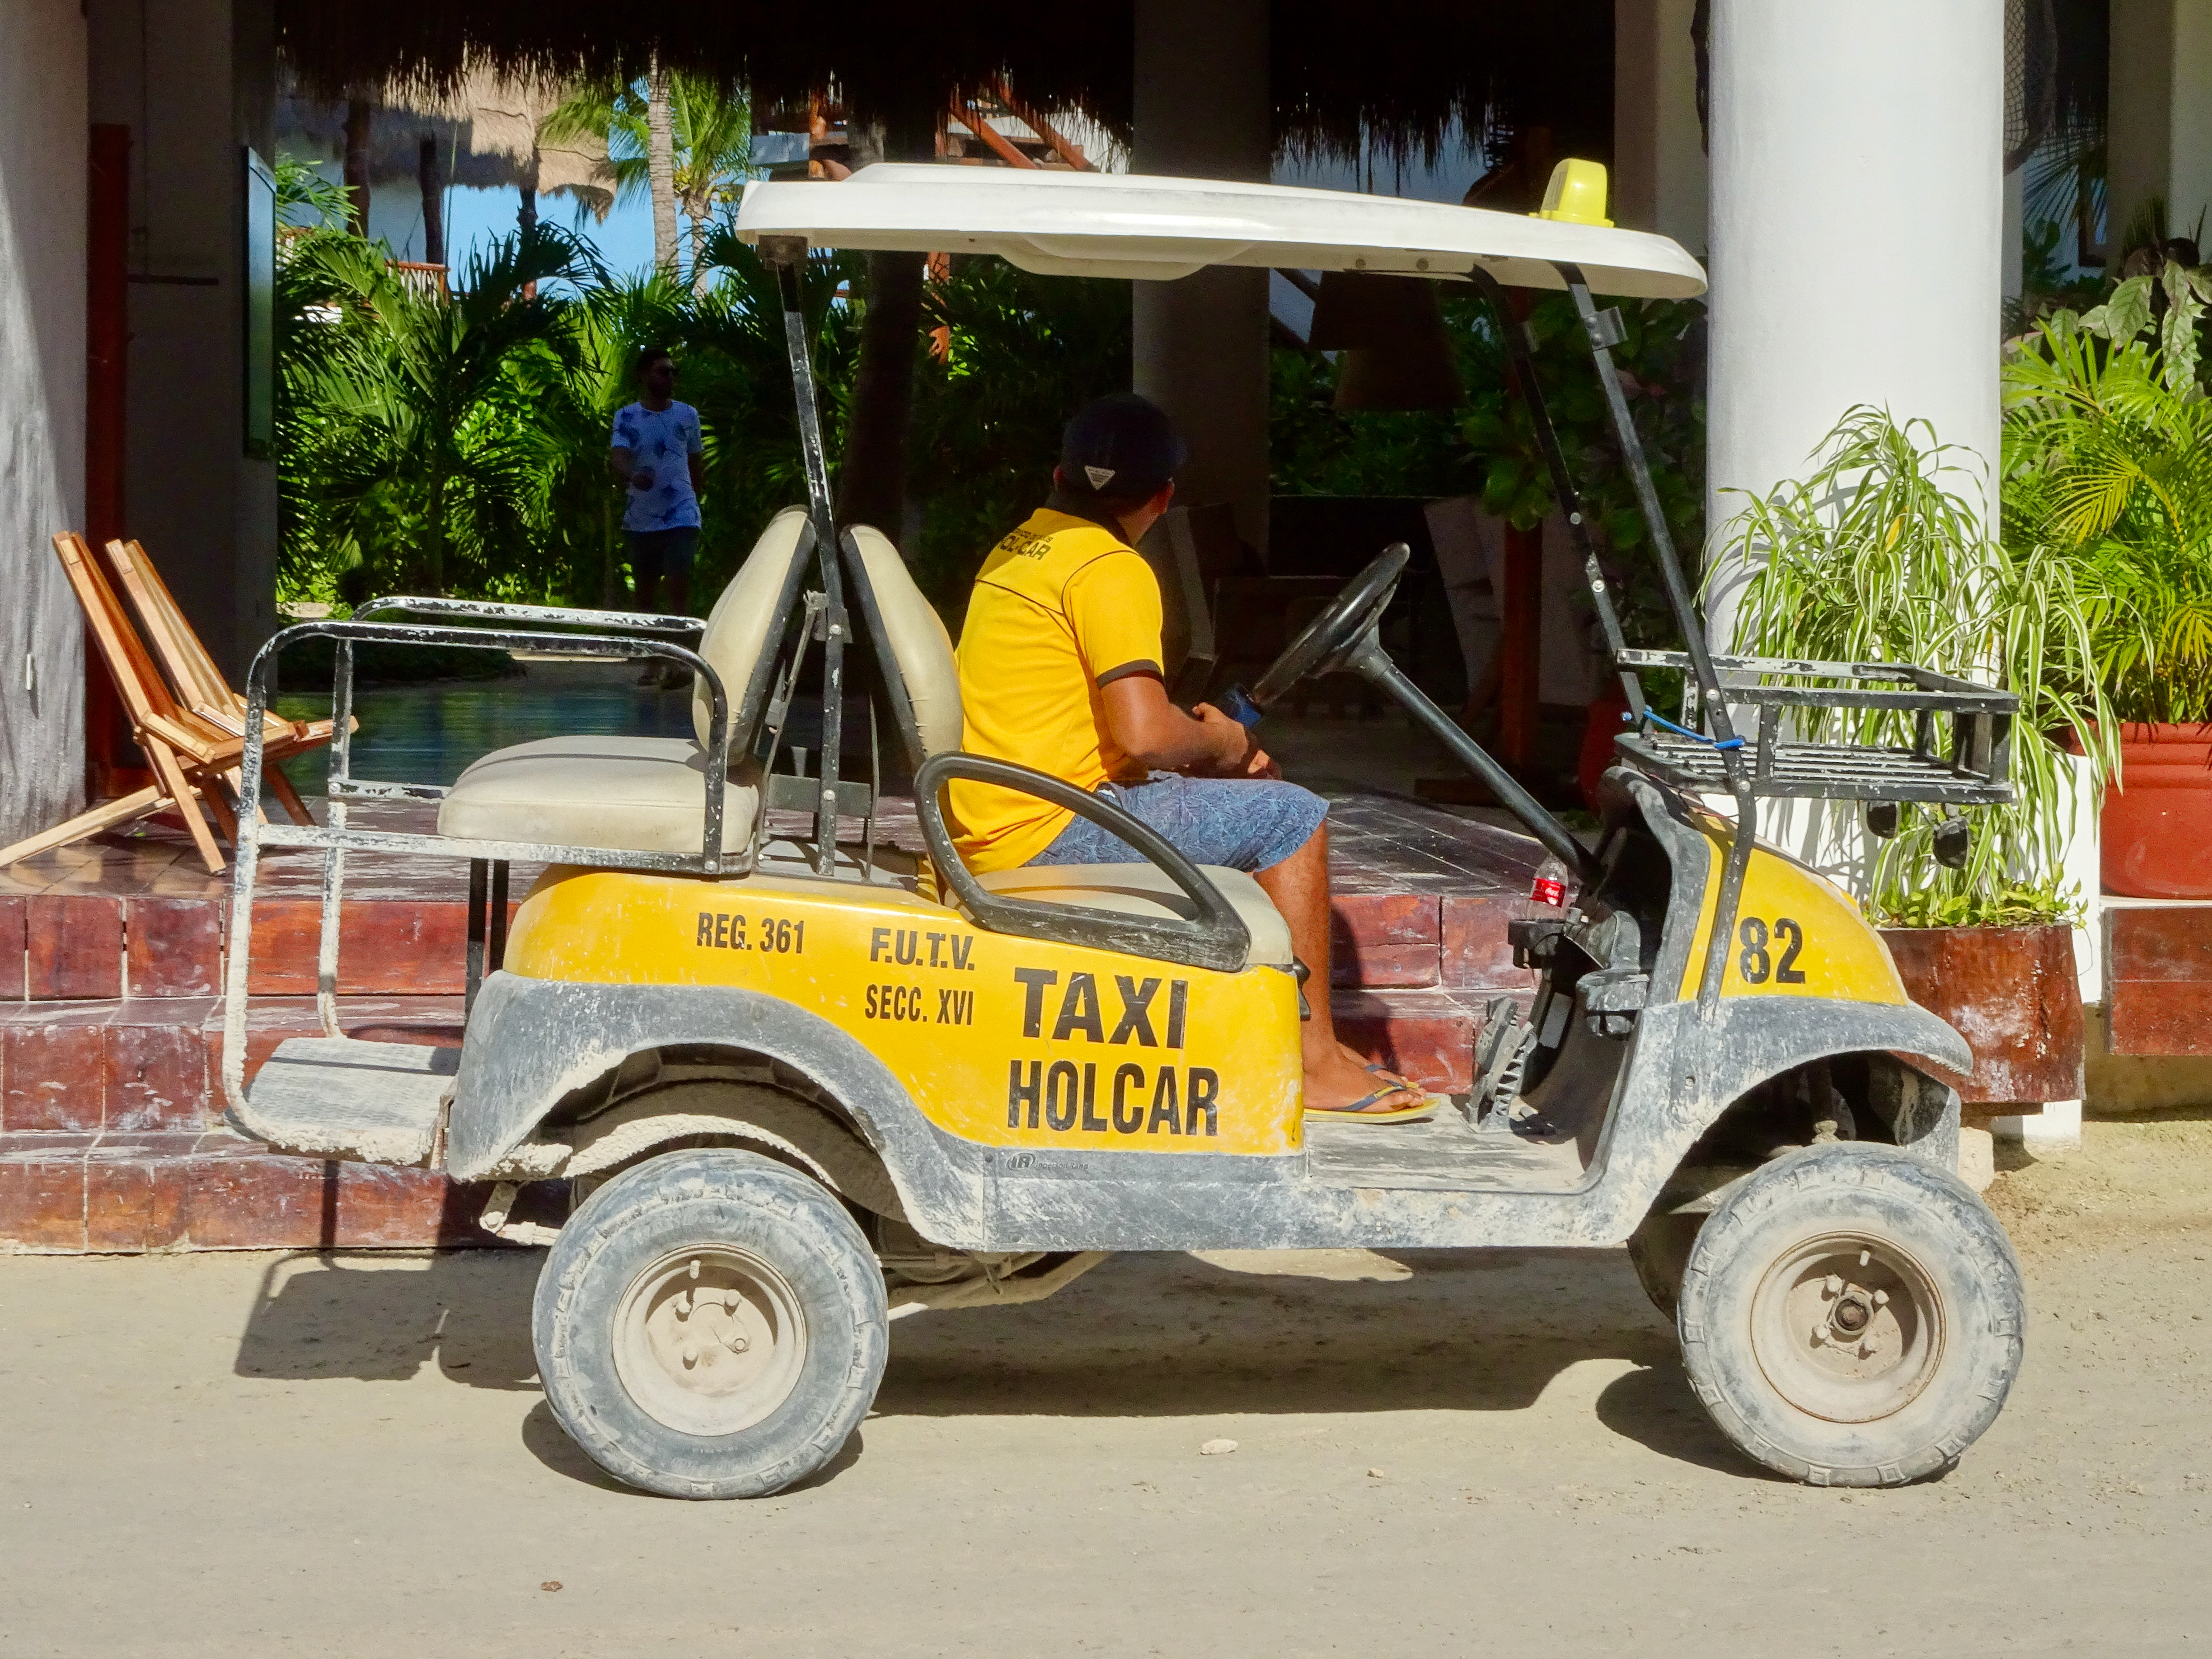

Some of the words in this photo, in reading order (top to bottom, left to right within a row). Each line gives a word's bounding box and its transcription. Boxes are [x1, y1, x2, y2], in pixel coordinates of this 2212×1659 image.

[999, 535, 1052, 561] OLCAR
[696, 912, 752, 950] REG.
[759, 918, 804, 954] 361
[870, 927, 975, 970] F.U.T.V.
[1739, 916, 1806, 984] 82
[864, 984, 928, 1022] SECC.
[936, 989, 974, 1026] XVI
[1013, 966, 1189, 1050] TAXI
[1007, 1059, 1219, 1136] HOLCAR
